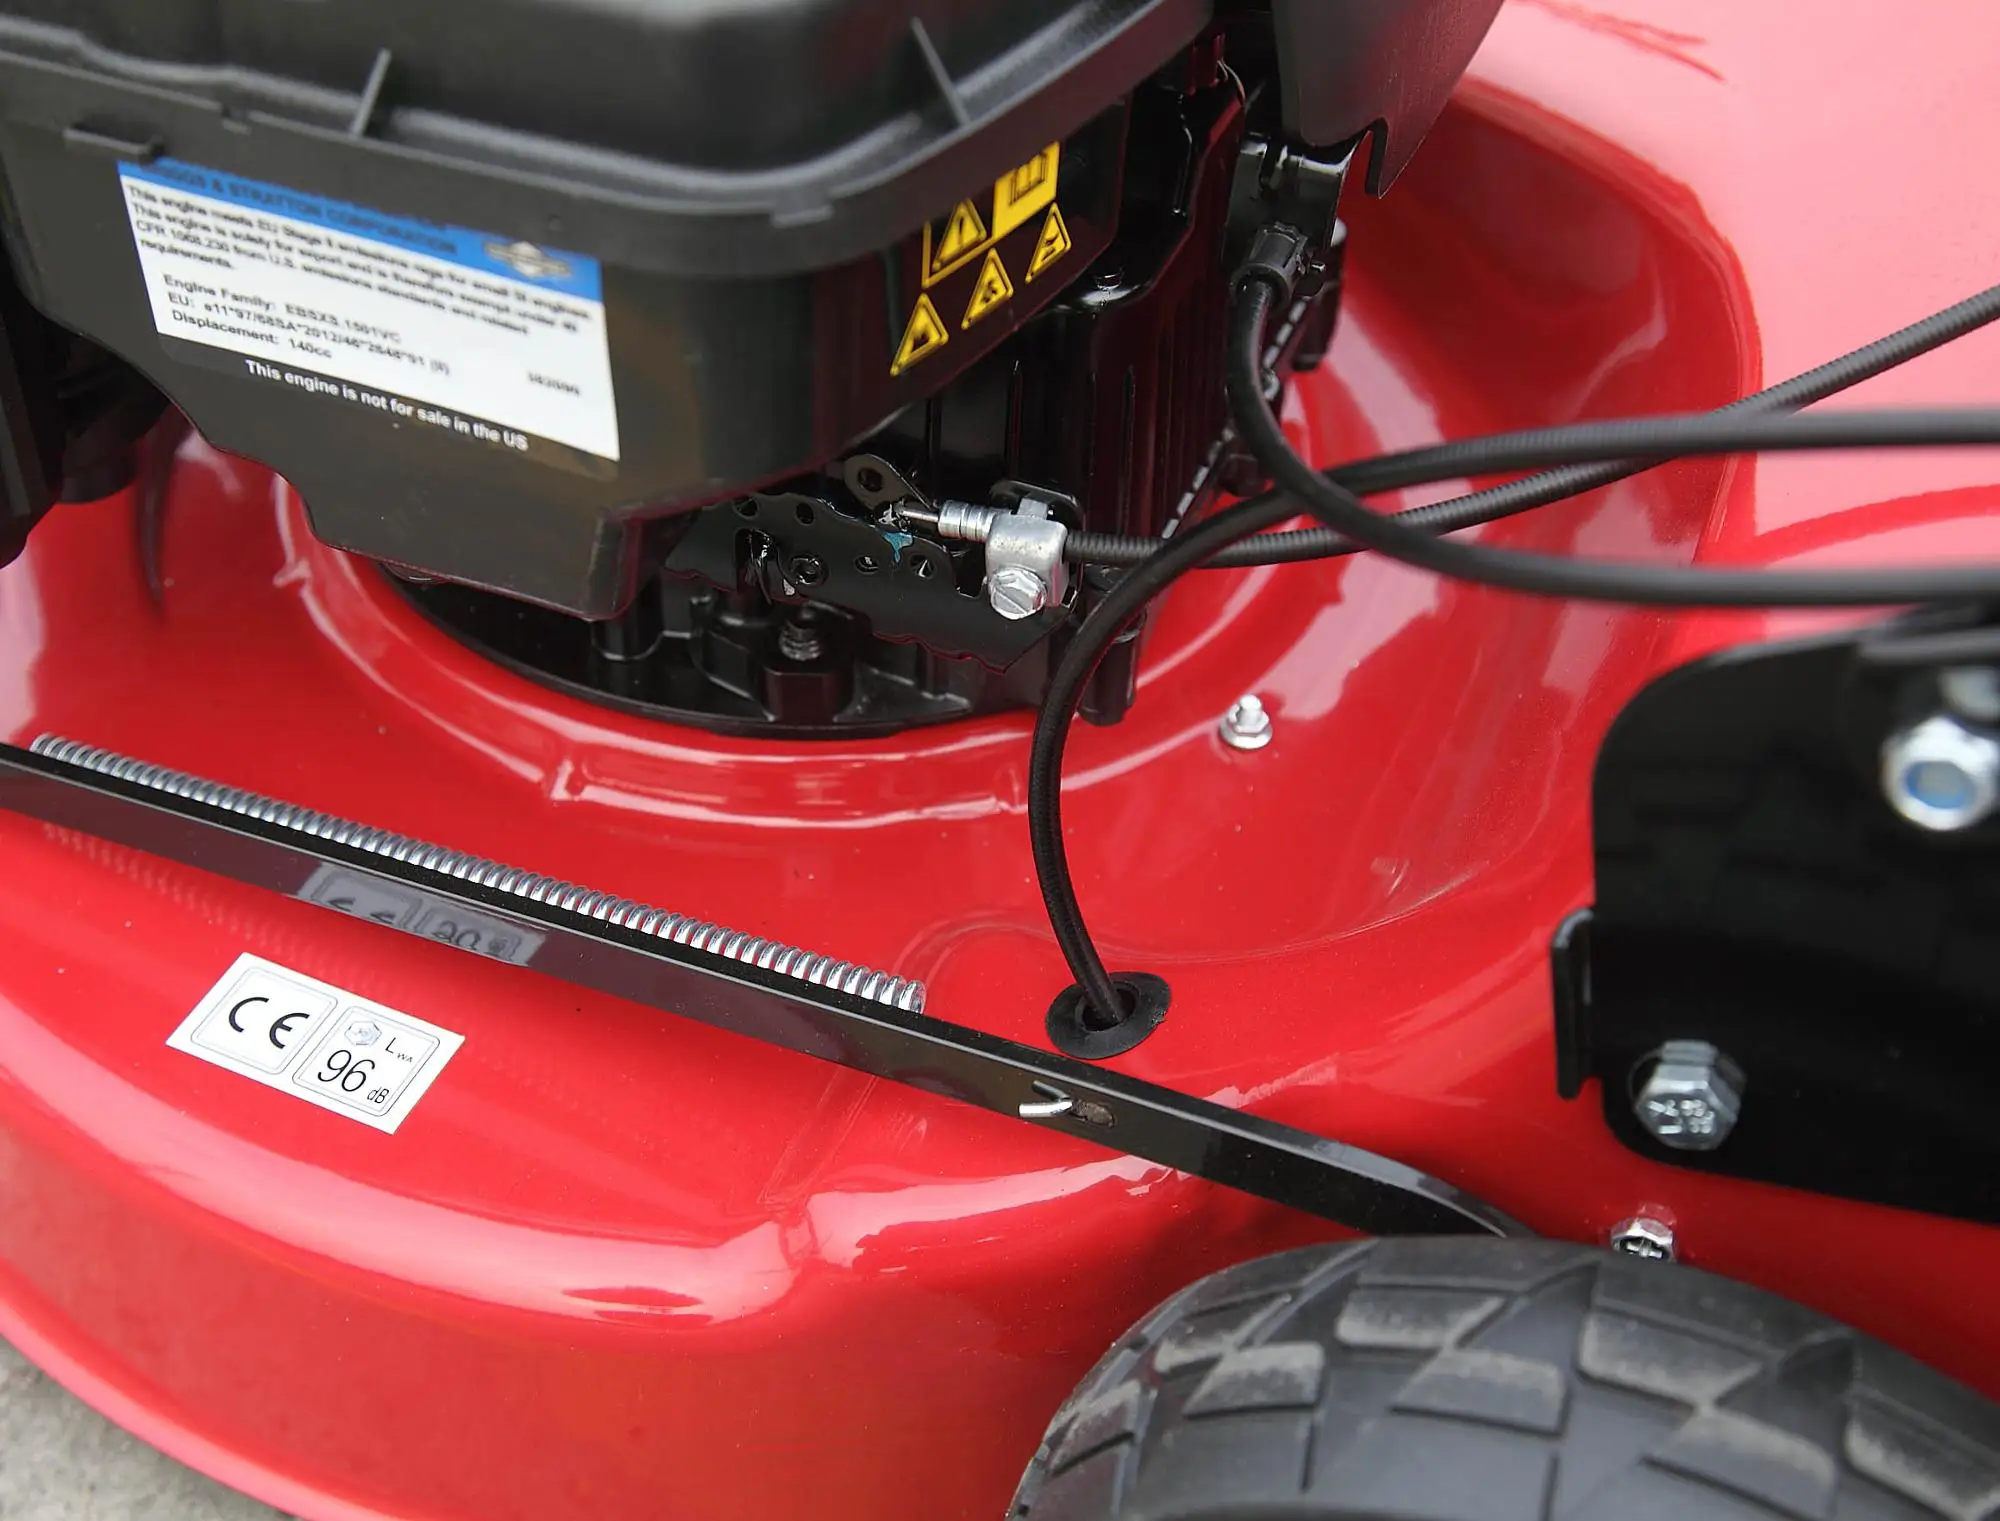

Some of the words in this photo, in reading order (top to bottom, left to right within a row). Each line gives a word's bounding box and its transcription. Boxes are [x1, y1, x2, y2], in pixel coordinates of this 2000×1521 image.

[128, 185, 156, 201] This
[162, 195, 205, 214] engine
[132, 203, 160, 218] This
[166, 212, 210, 230] engine
[163, 273, 216, 295] Engine
[221, 286, 275, 312] Family:
[168, 291, 194, 308] EU:
[172, 308, 278, 344] Displacement:
[289, 338, 331, 358] 140cc
[246, 358, 280, 380] This
[284, 368, 339, 395] engine
[342, 384, 356, 400] is
[361, 390, 386, 409] not
[390, 397, 414, 416] for
[416, 405, 451, 427] sale
[454, 416, 470, 433] in
[473, 421, 500, 442] the
[503, 429, 528, 450] US
[228, 996, 310, 1050] CE
[317, 1049, 375, 1093] 96
[366, 1086, 390, 1105] dB
